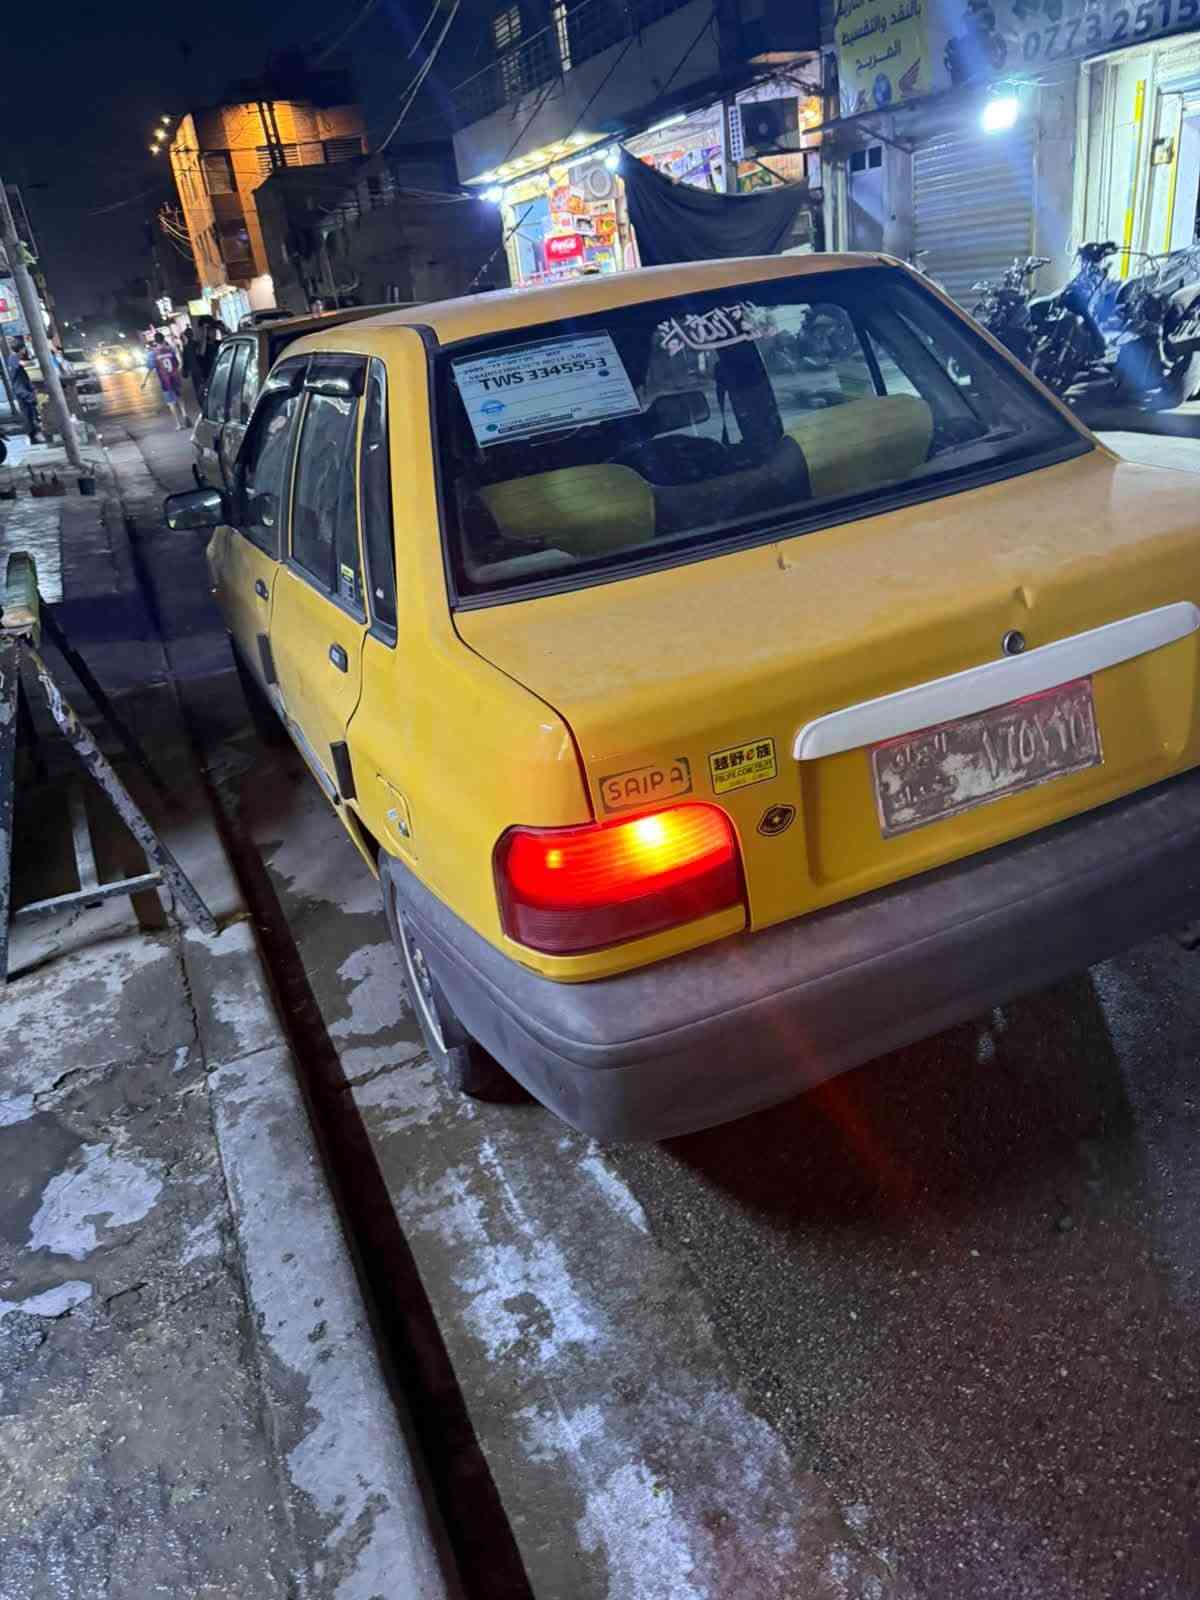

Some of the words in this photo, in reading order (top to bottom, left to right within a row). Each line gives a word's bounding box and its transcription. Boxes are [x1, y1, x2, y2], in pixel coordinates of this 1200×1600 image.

[478, 368, 524, 391] TWS
[529, 357, 608, 382] 3345553
[608, 766, 684, 801] SAIPA
